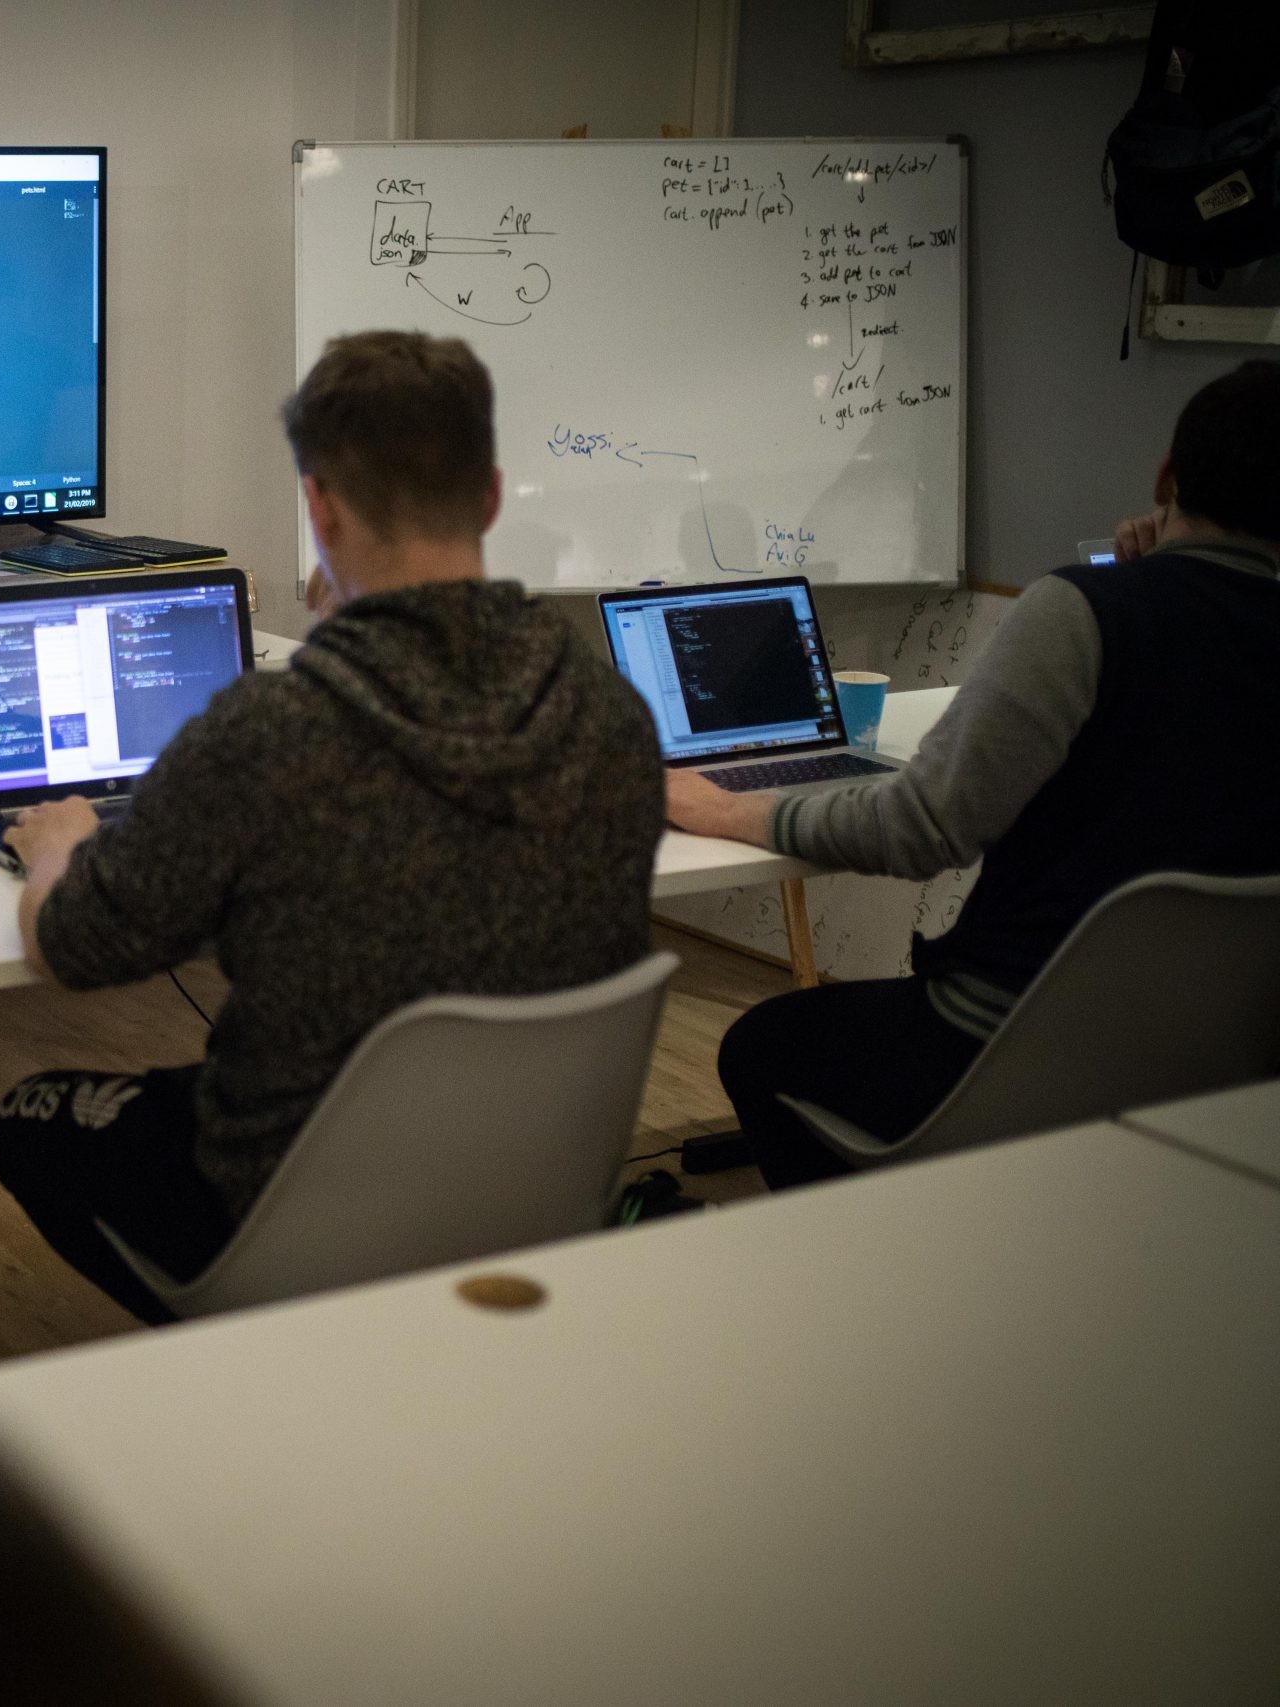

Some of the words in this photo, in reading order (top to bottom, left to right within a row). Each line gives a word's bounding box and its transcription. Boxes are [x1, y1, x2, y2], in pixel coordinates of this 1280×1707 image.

[664, 156, 693, 173] cart
[713, 155, 729, 173] []
[21, 186, 46, 195] pets.html
[377, 178, 426, 195] CART
[662, 178, 688, 197] pet
[691, 184, 702, 192] =
[499, 205, 531, 233] App
[819, 224, 837, 245] get
[844, 222, 861, 239] the
[870, 222, 889, 244] pet
[819, 246, 837, 269] get
[846, 244, 866, 256] the
[929, 225, 957, 248] JSON
[820, 265, 839, 282] add
[844, 265, 862, 285] pet
[869, 266, 881, 279] to
[846, 290, 858, 303] to
[864, 284, 896, 303] JSON
[836, 406, 854, 430] get
[922, 384, 952, 402] JSON
[63, 476, 81, 484] Python
[68, 489, 80, 498] 3:11
[64, 499, 96, 508] 21/02/2019
